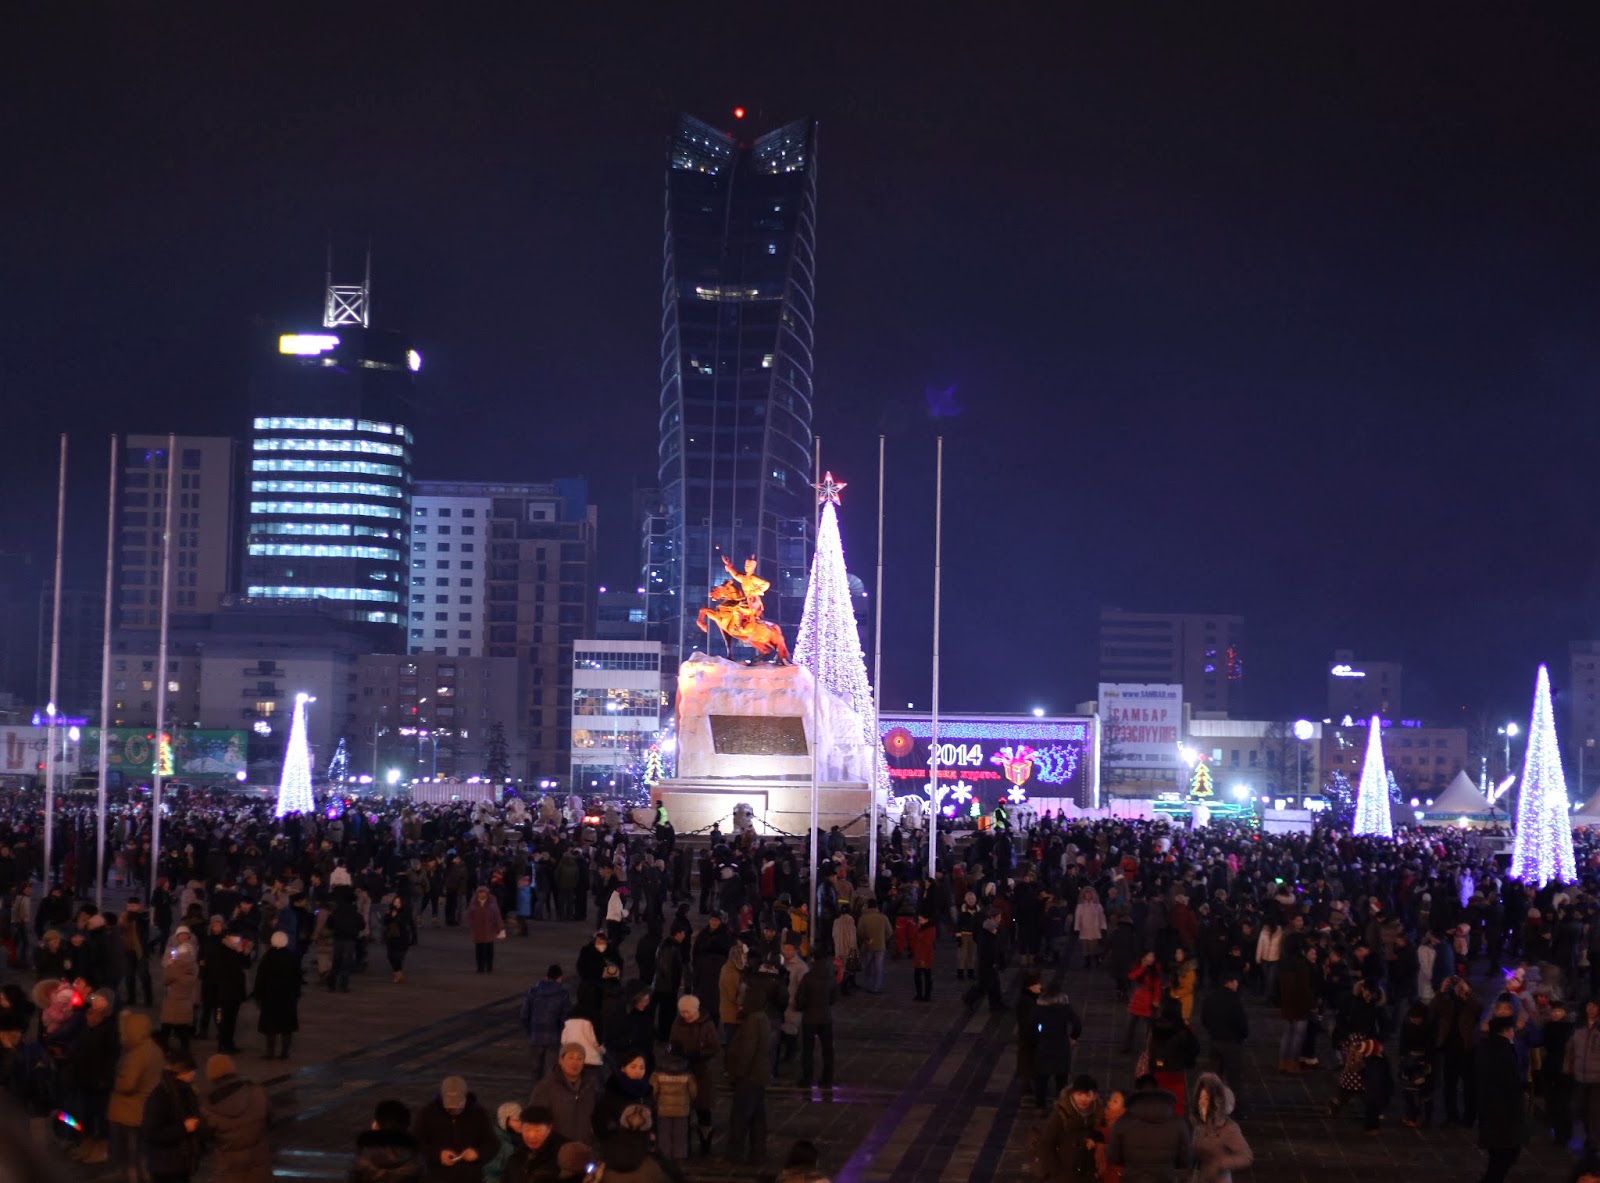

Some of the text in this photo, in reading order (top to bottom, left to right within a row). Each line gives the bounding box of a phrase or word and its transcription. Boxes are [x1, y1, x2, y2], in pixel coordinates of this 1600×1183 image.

[1112, 708, 1168, 722] САМБАР
[1102, 725, 1177, 743] РЭЭСЛҮҮЛНЭ
[927, 743, 983, 765] 2014
